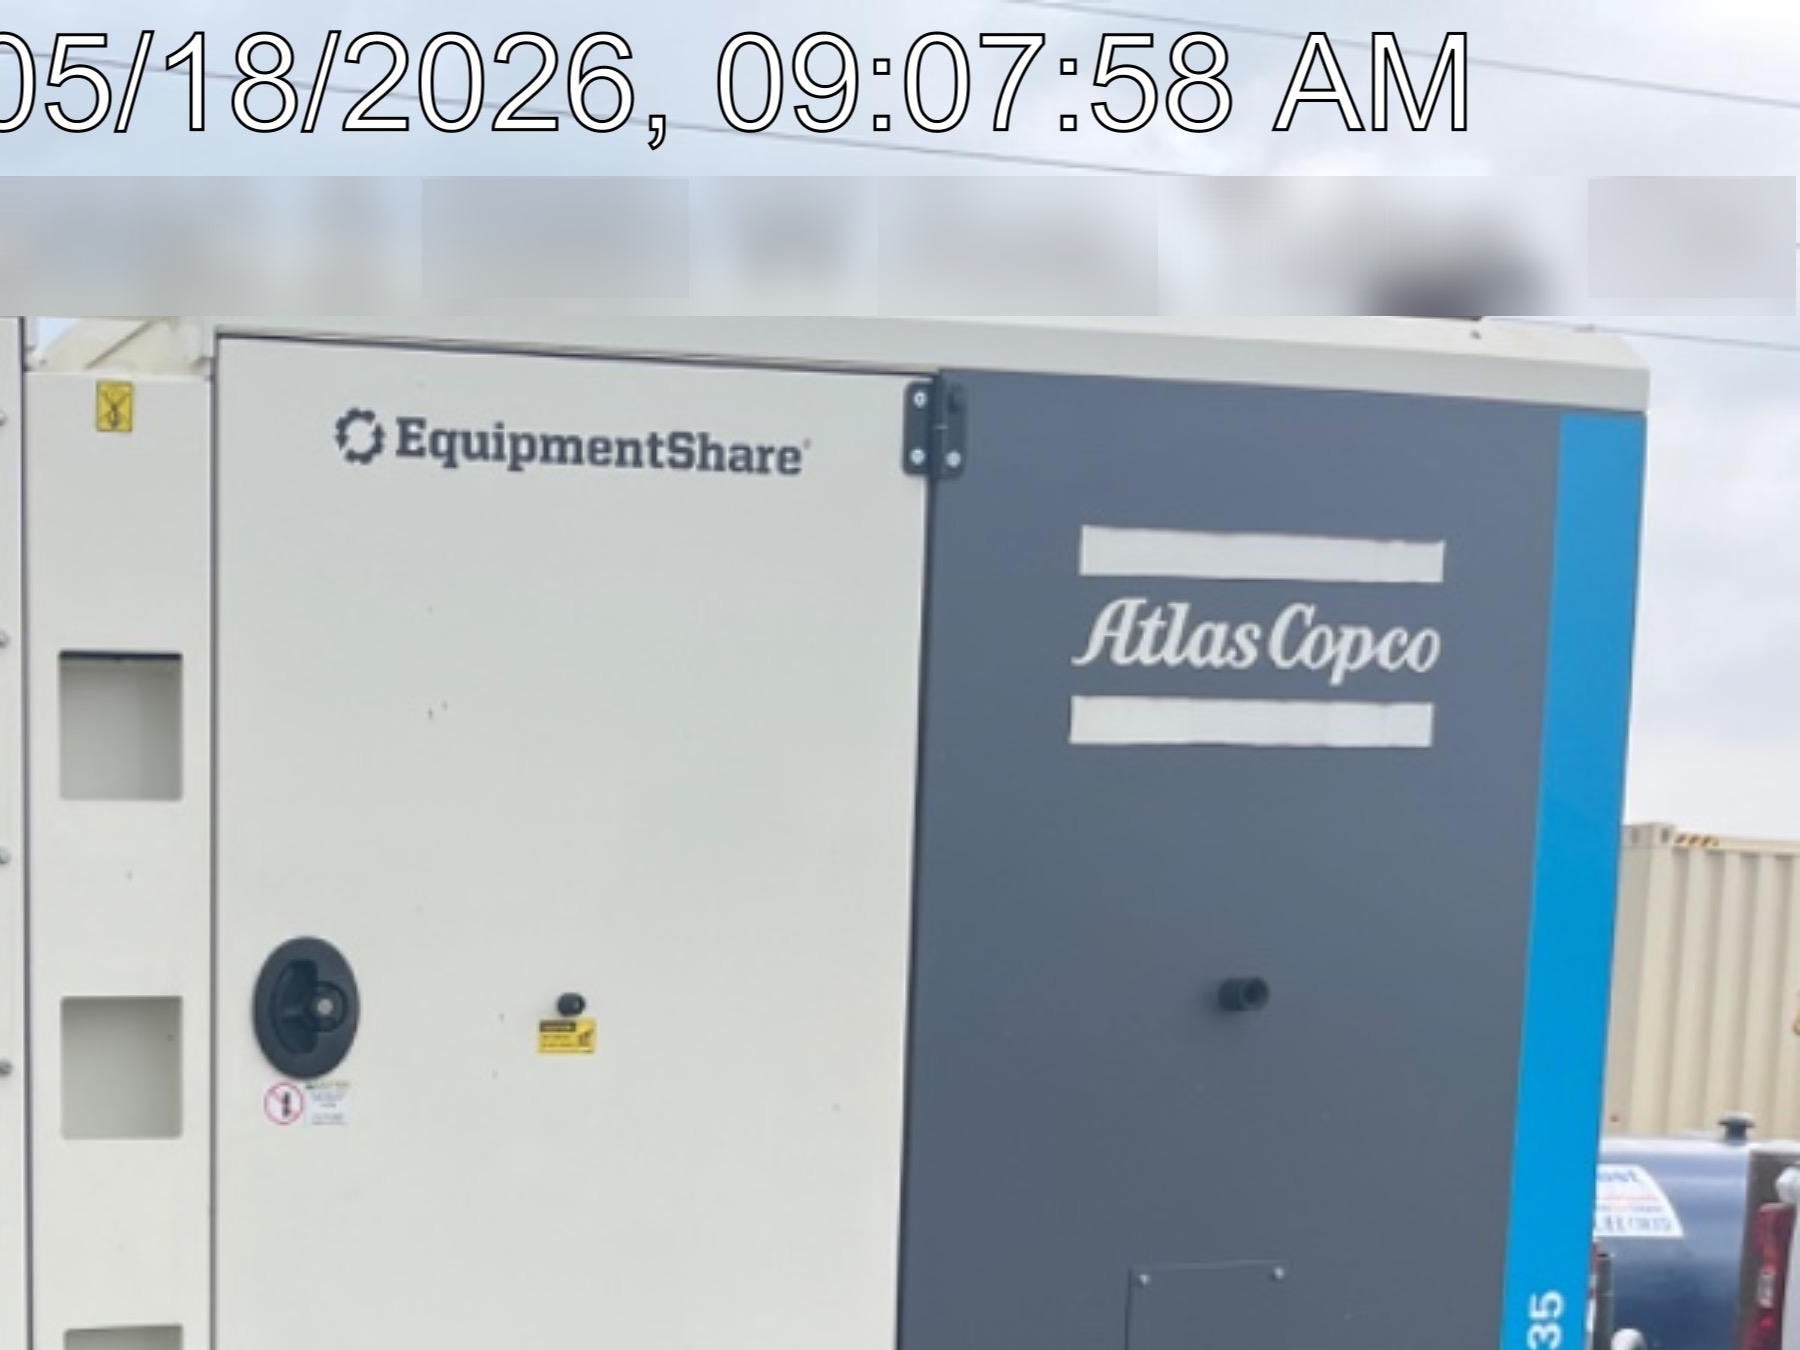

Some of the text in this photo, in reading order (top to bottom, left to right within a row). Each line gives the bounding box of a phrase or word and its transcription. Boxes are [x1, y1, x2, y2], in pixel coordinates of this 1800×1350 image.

[394, 416, 803, 478] EquipmentShare
[1071, 596, 1442, 686] Atlas Copco
